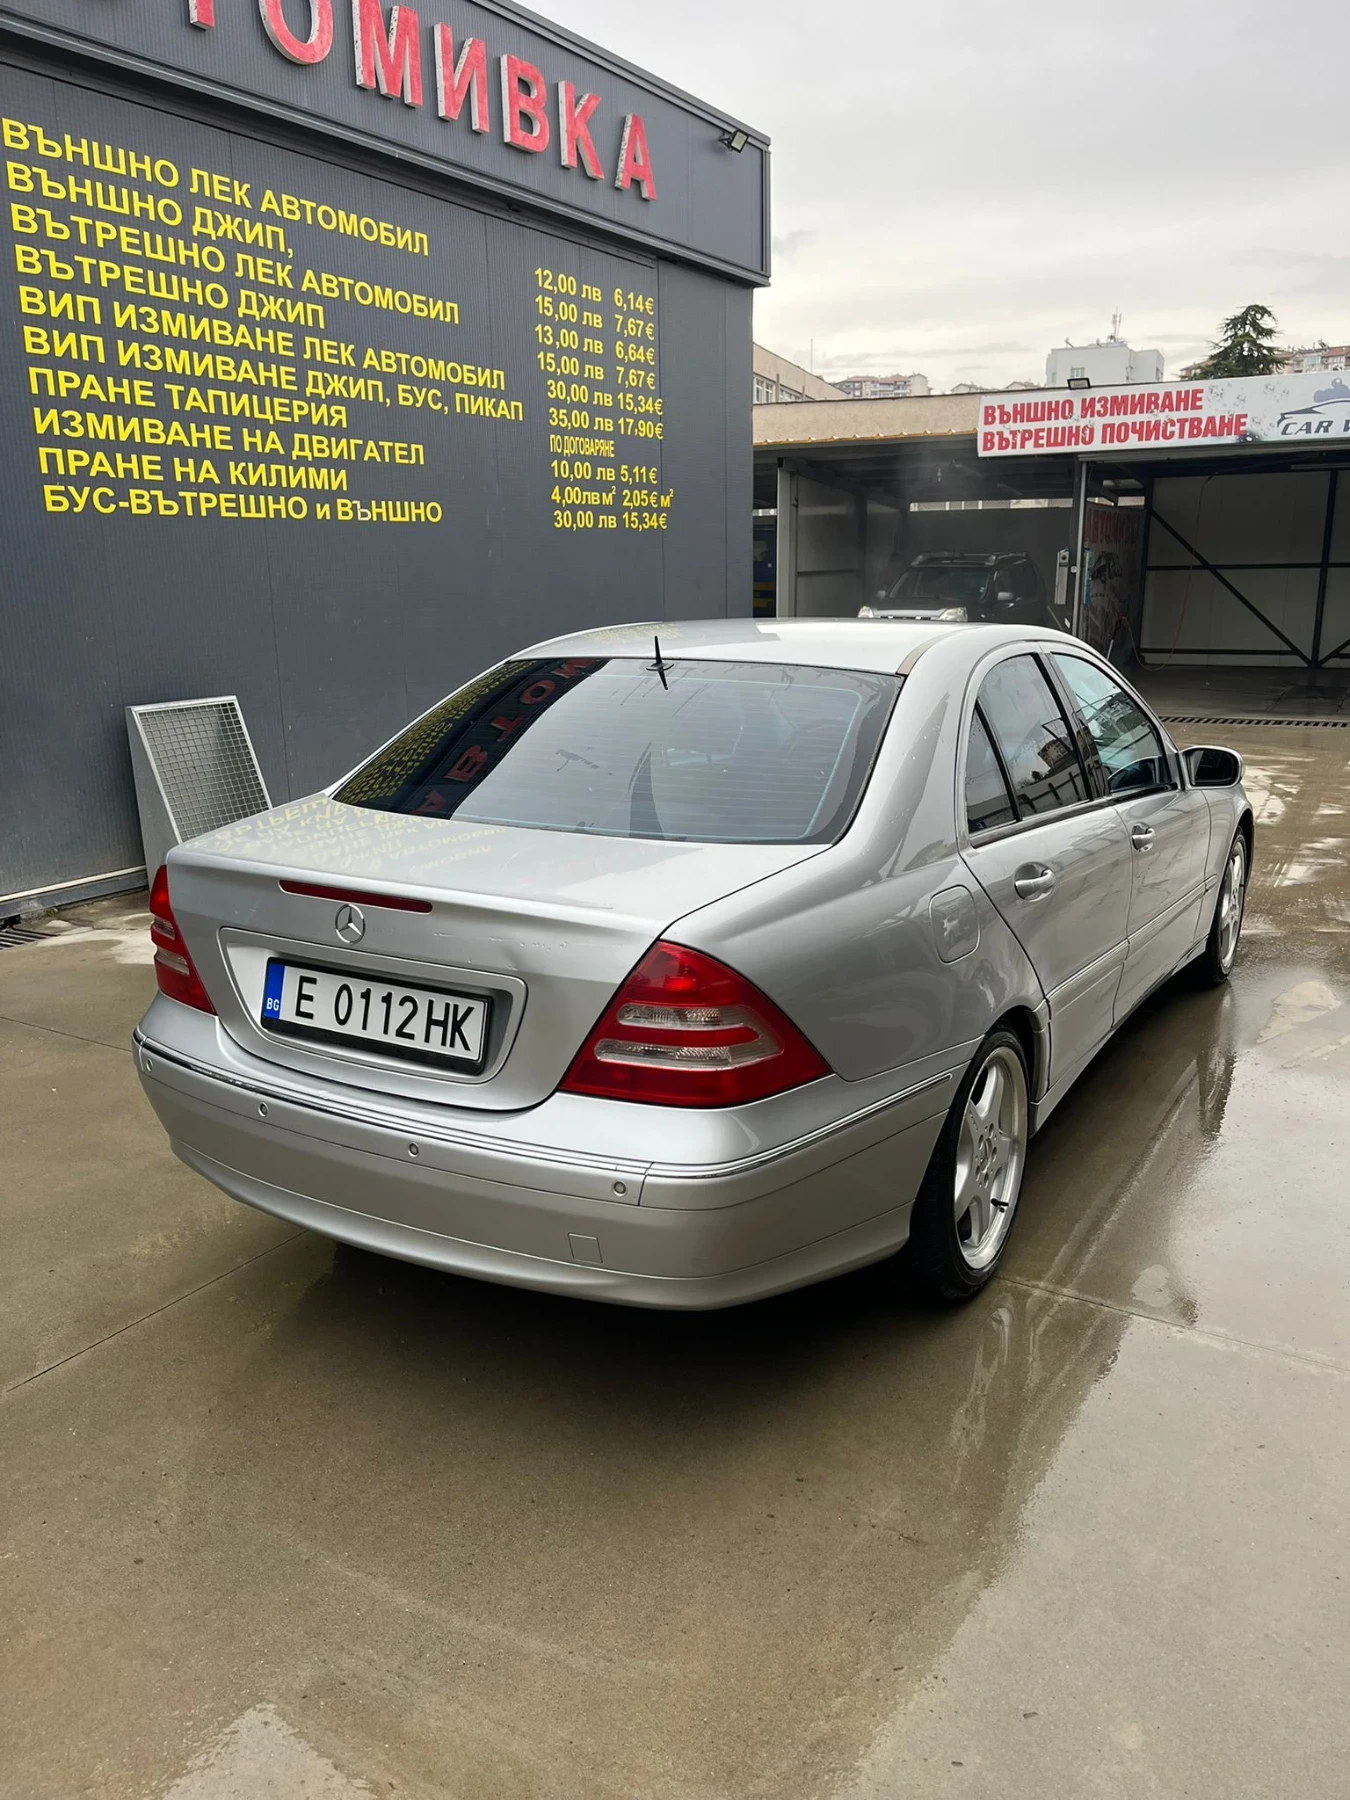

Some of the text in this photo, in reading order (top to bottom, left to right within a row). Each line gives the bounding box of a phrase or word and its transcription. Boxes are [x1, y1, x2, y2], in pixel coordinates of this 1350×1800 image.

[188, 0, 657, 201] ОМИВКА
[1, 117, 429, 257] ВЪНШНО ЛЕК АВТОМОБИЛ
[6, 160, 294, 257] ВЪНШНО ДЖИП,
[10, 202, 460, 325] ВЪТРЕШНО ЛЕК АВТОМОБИЛ
[14, 243, 326, 330] ВЪТРЕШНО ДЖИП
[535, 267, 655, 315] 12,00 лв 6,14€
[18, 285, 506, 391] ВИП ИЗМИВАНЕ ЛЕК АВТОМОБИЛ
[535, 295, 655, 341] 15,00 лв 7,67€
[535, 323, 655, 366] 13,00 лв 6,64€
[23, 325, 524, 422] ВИП ИЗМИВАНЕ ДЖИП, БУС, ПИКАП
[537, 351, 656, 390] 15,00 лв 7,67€
[28, 366, 348, 429] ПРАНЕ ТАПИЦЕРИЯ
[547, 379, 664, 416] 30,00 лв 15,34€
[549, 407, 589, 430] 35,00
[593, 416, 614, 432] лв
[983, 389, 1204, 425] ВЪНШНО ИЗМИВАНЕ
[33, 406, 425, 465] ИЗМИВАНЕ НА ДВИГАТЕЛ
[549, 434, 562, 453] ПО
[982, 413, 1248, 452] ВЪТРЕШНО ПОЧИСТВАНЕ
[1280, 420, 1334, 436] CAR
[38, 446, 348, 492] ПРАНЕ НА КИЛИМИ
[551, 459, 592, 482] 10,00
[596, 467, 616, 481] лв
[43, 484, 443, 523] БУС-ВЪТРЕШНО и ВЪНШНО
[553, 510, 668, 532] 30,00 лв 15,34€
[266, 997, 280, 1011] BG
[295, 975, 318, 1020] E
